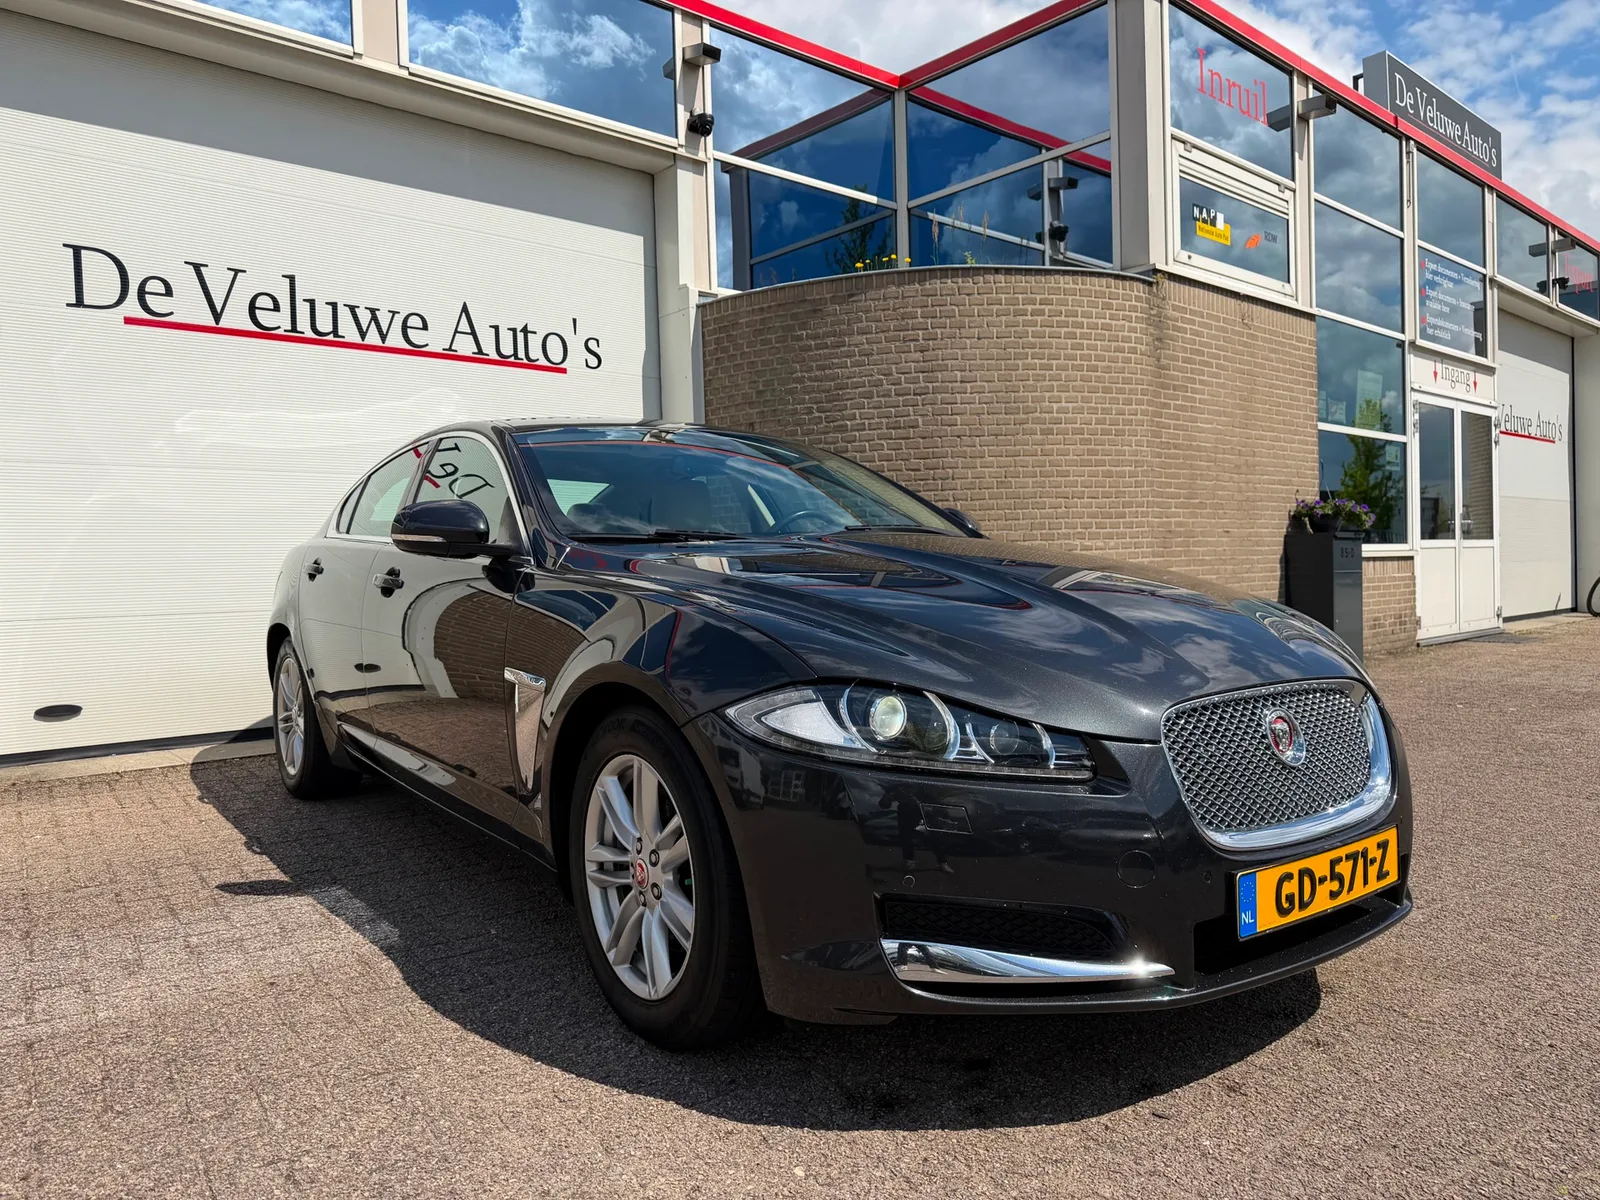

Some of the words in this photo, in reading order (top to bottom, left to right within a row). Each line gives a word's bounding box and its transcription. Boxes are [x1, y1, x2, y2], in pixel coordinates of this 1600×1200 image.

[1197, 47, 1269, 127] Inruil
[1394, 72, 1414, 114] De
[1415, 87, 1462, 145] Veluwe
[1462, 121, 1497, 167] Auto's
[1193, 205, 1216, 220] NAP
[1264, 230, 1278, 244] RDW
[62, 242, 175, 318] De
[183, 260, 430, 349] Veluwe
[442, 300, 603, 370] Auto's
[1440, 358, 1471, 393] Ingang
[1535, 410, 1563, 442] Auto's
[1275, 838, 1390, 918] GD-571-Z
[1241, 910, 1255, 926] NL
